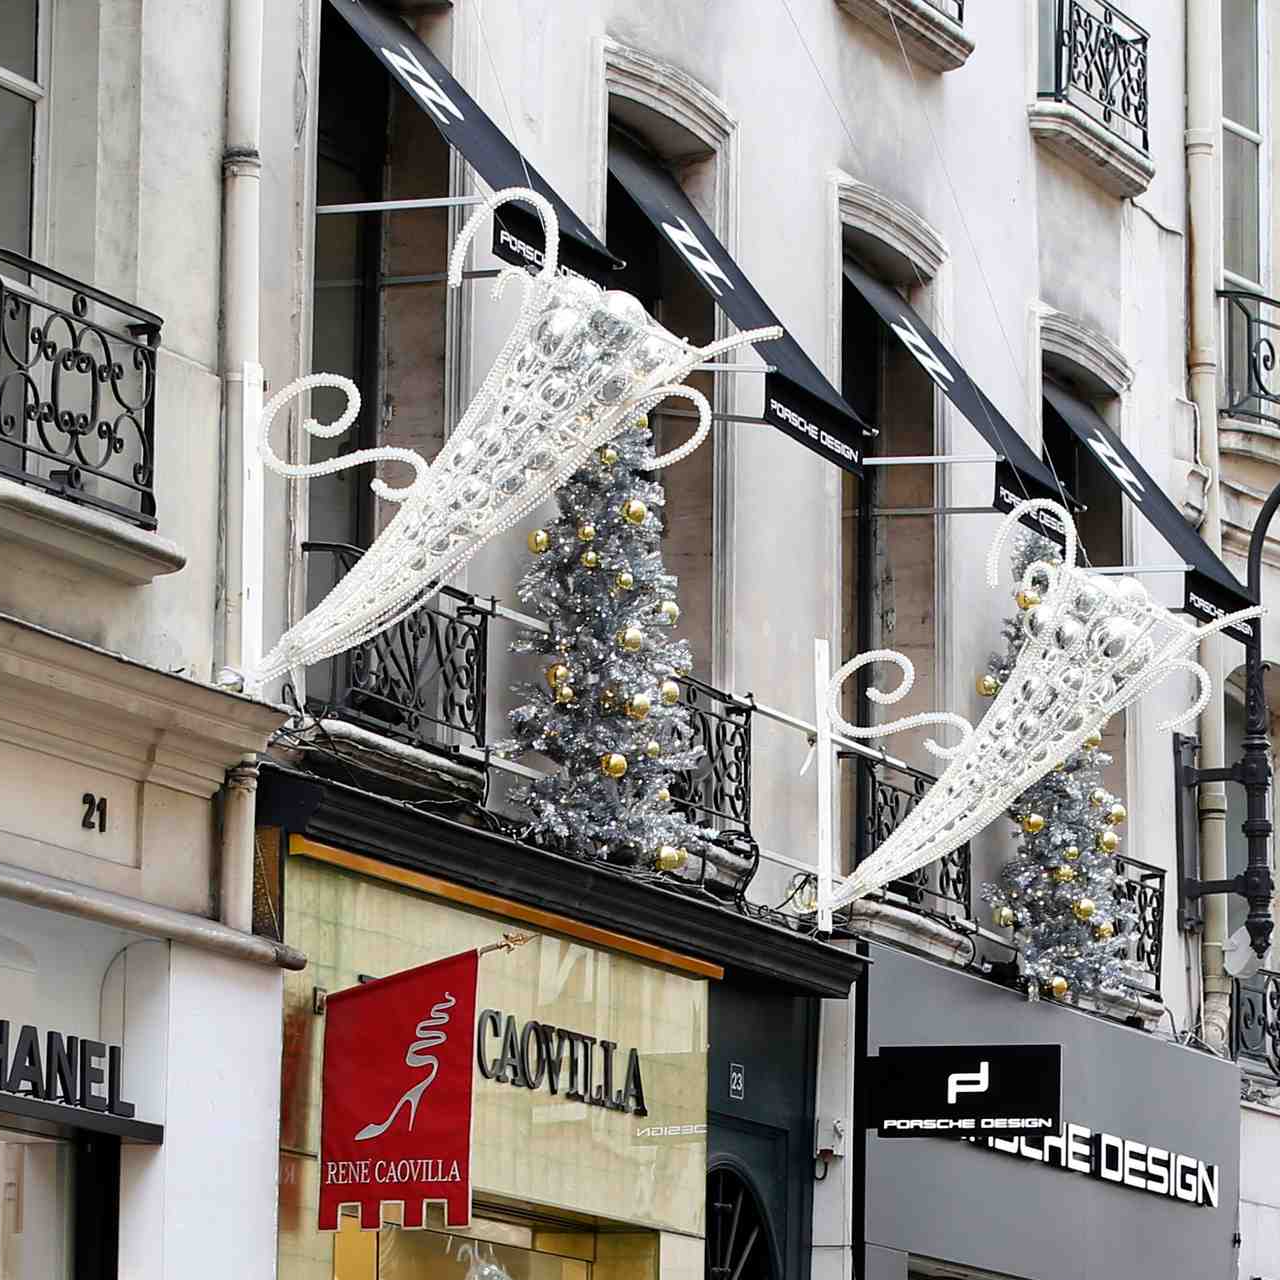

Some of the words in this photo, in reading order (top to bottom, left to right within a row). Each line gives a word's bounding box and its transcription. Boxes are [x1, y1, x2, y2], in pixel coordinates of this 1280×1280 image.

[500, 230, 550, 268] PORSC
[770, 398, 820, 441] PORSCHE
[819, 430, 859, 464] DESIGN
[81, 793, 108, 833] 21
[477, 1008, 648, 1117] CAOVILLA
[730, 1072, 743, 1092] 23
[883, 1118, 976, 1130] PORSCHE
[980, 1117, 1053, 1129] DESIGN
[375, 1159, 462, 1184] CAOVILLA
[1099, 1132, 1219, 1209] DESIGN
